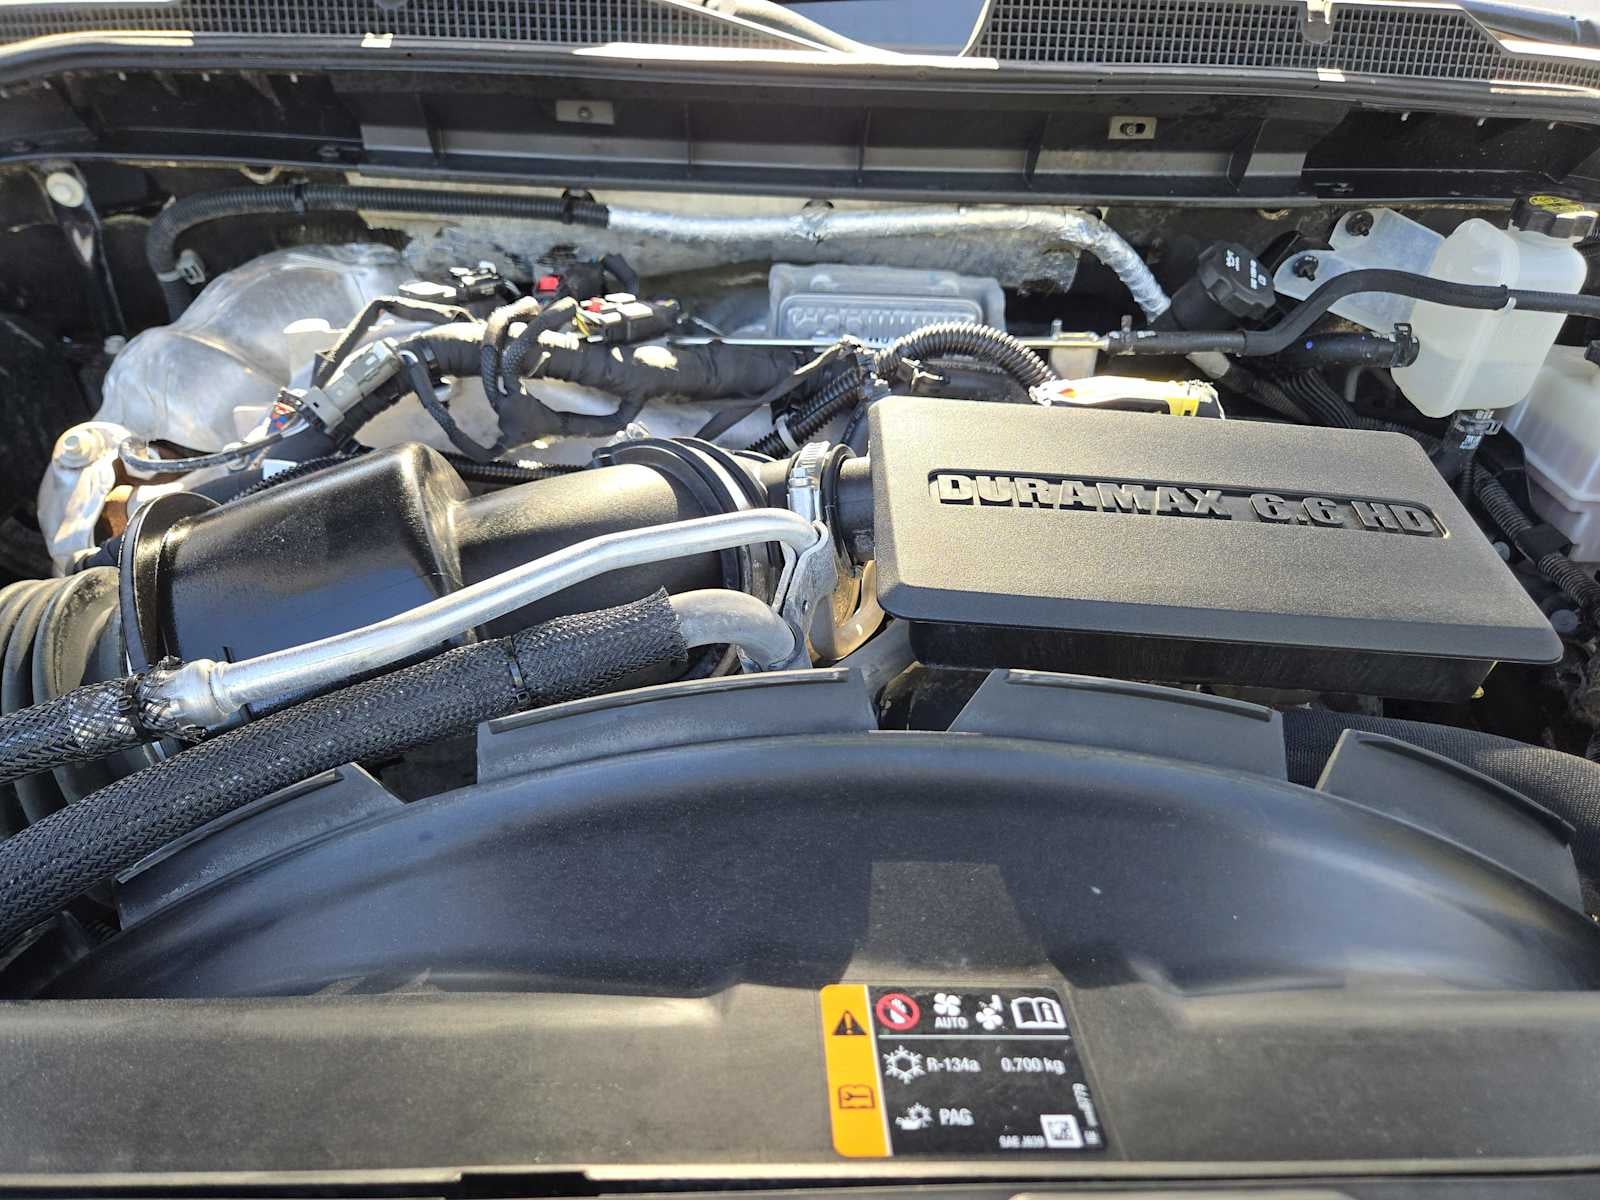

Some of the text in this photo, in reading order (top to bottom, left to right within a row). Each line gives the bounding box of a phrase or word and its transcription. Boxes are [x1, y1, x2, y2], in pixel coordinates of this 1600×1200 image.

[936, 474, 1438, 536] DURAMAX 6.6 HD
[934, 1016, 969, 1030] AUTO
[926, 1057, 1066, 1076] R-134a 0.700 kg
[938, 1108, 975, 1126] PAG
